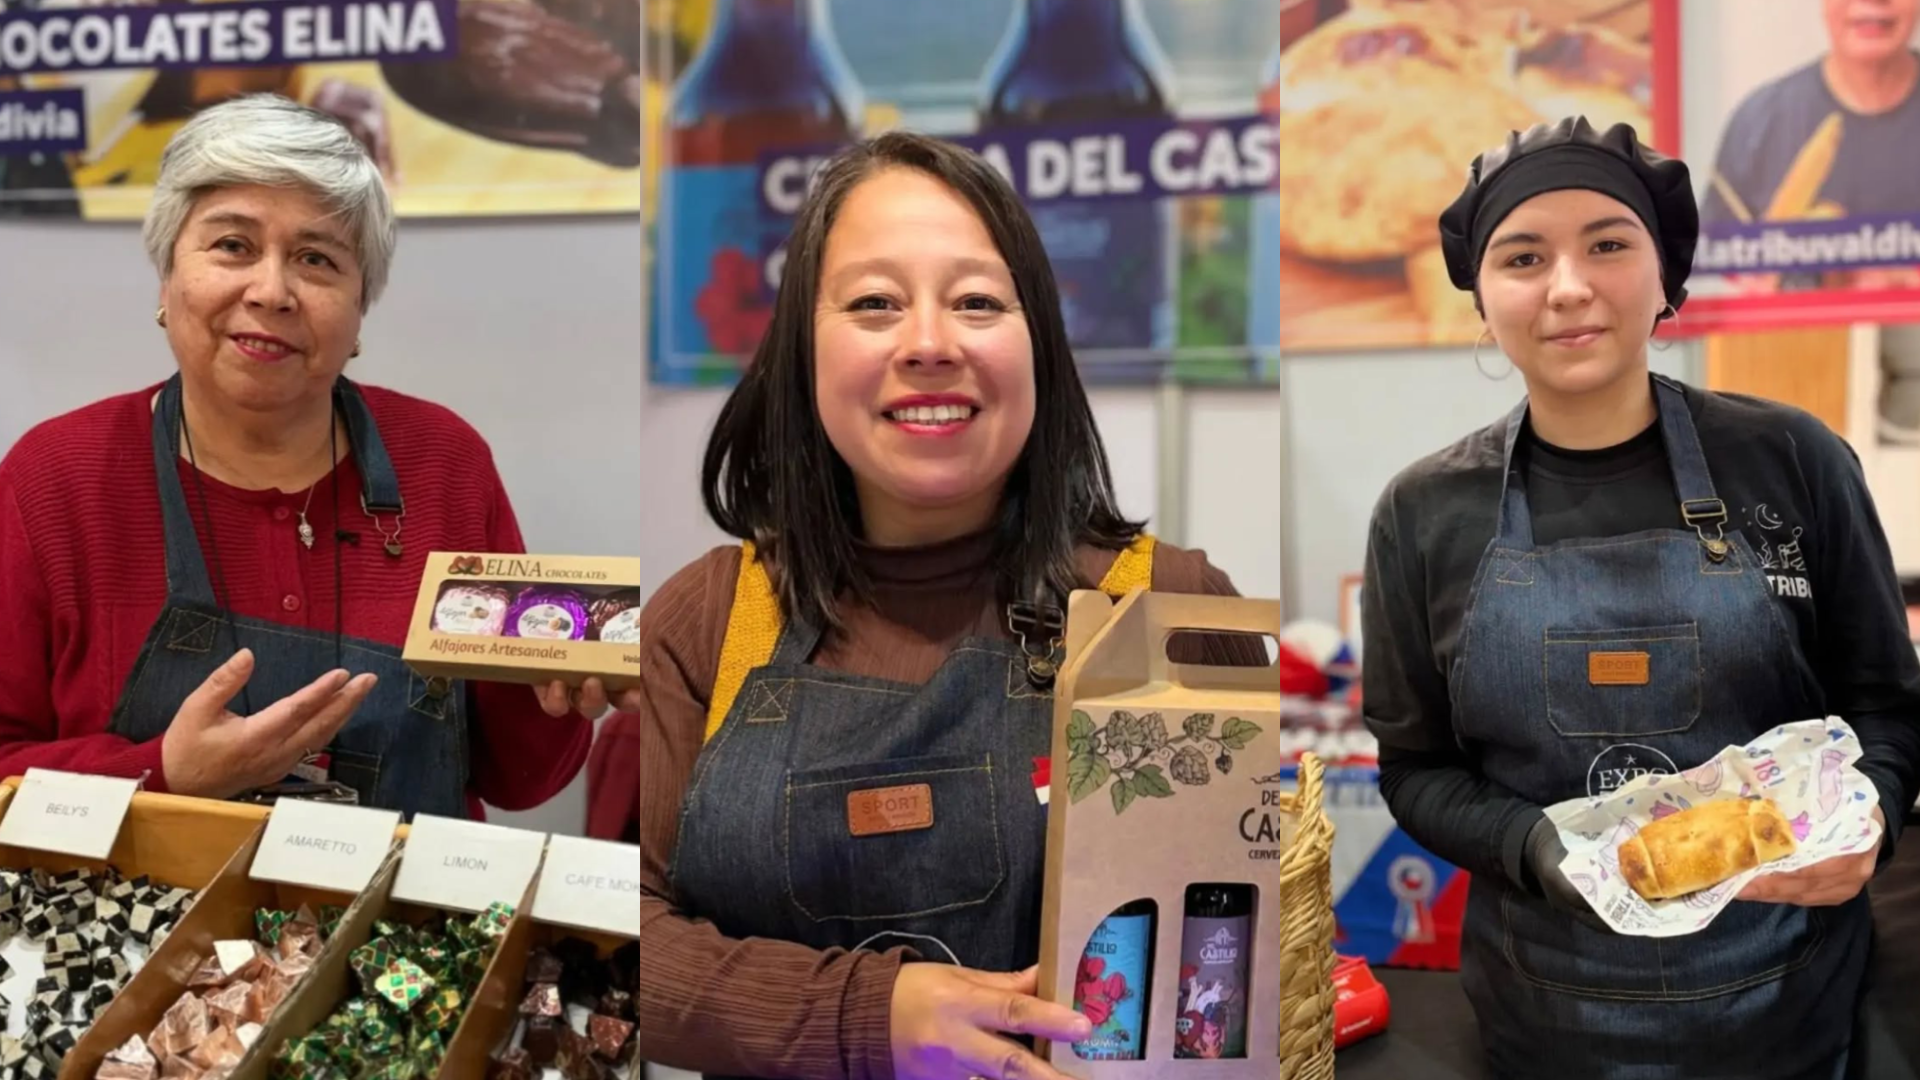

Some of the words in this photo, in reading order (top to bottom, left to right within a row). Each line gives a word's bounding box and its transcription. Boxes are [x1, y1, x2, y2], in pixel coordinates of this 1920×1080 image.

[283, 1, 445, 58] ELINA
[1026, 134, 1143, 197] DEL
[1150, 126, 1277, 189] CAS
[485, 559, 541, 577] ELINA
[545, 569, 607, 580] CHOCOLATES
[1766, 575, 1812, 599] TRIB
[430, 639, 485, 655] Alfajores
[488, 641, 567, 660] Artesanales
[1598, 660, 1639, 670] SPORT
[45, 802, 90, 818] BEILY'S
[861, 796, 920, 815] SPORT
[284, 834, 357, 856] AMARETTO
[443, 855, 489, 872] LIMON
[565, 873, 605, 890] CAFE
